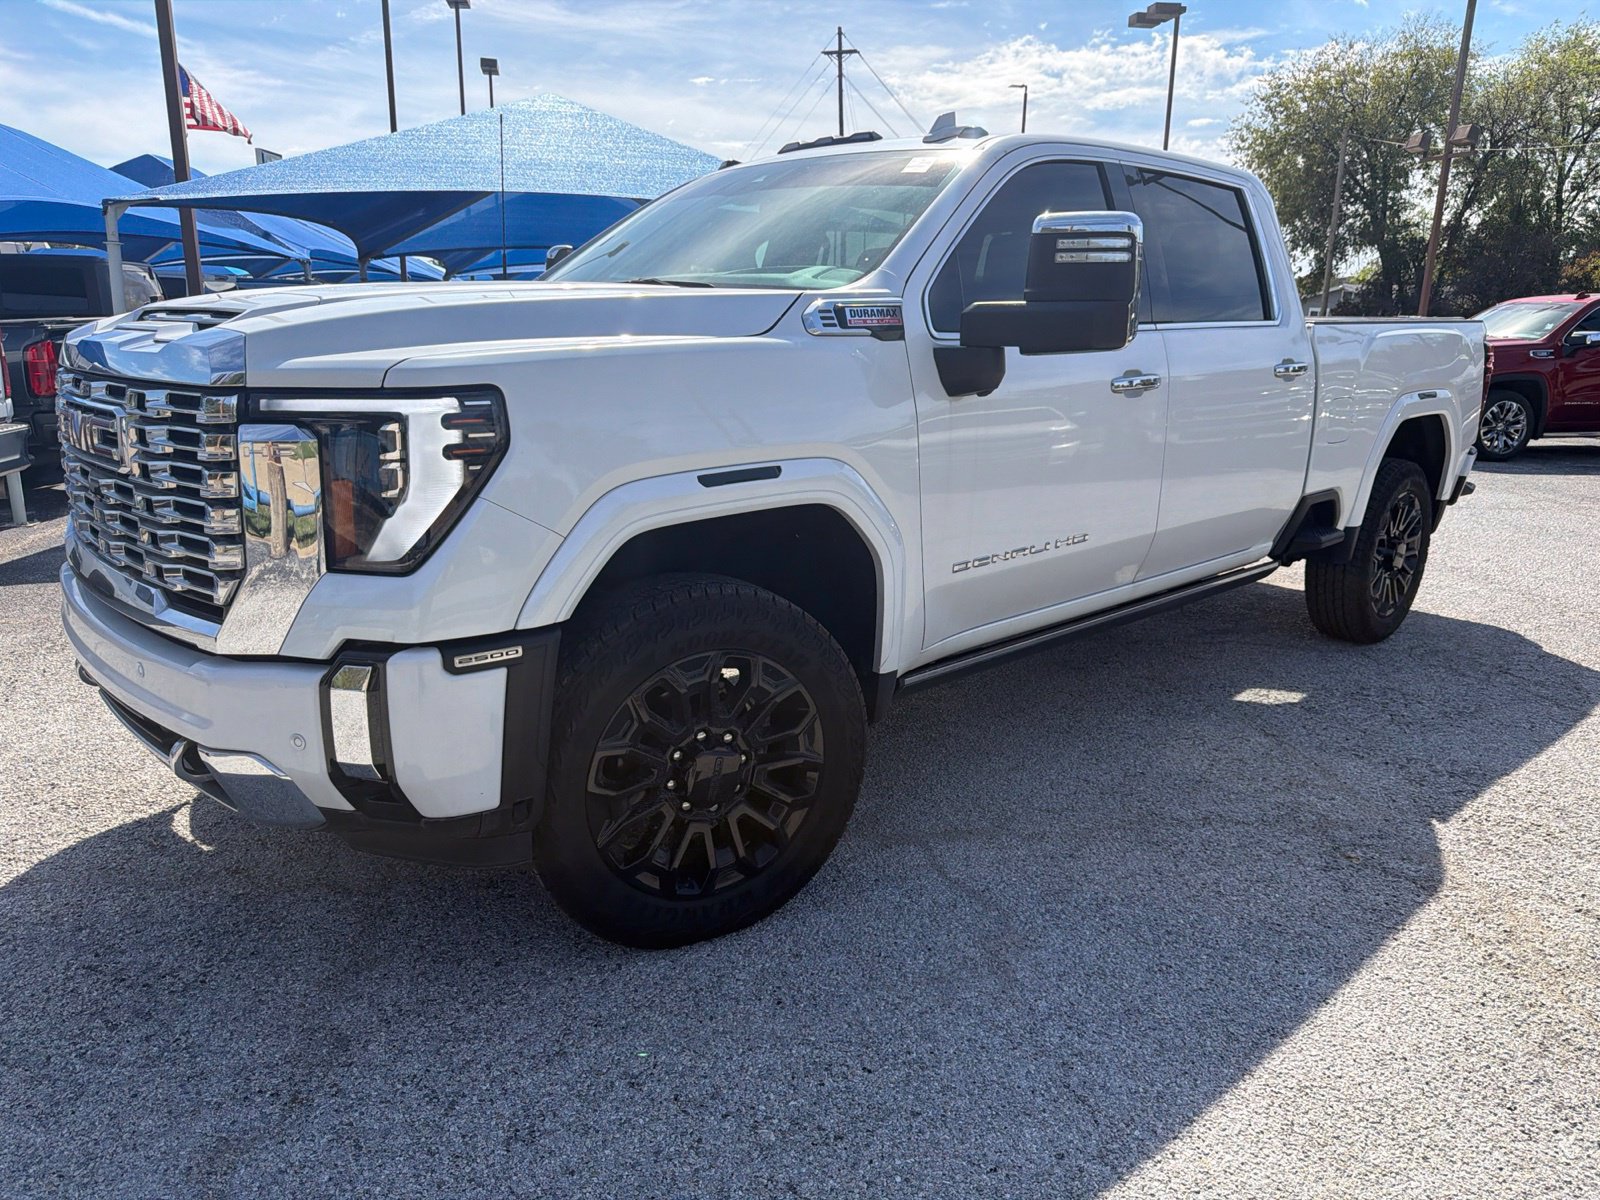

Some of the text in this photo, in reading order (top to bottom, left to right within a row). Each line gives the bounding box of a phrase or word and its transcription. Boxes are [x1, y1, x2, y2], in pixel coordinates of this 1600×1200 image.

[849, 307, 899, 319] DURAMAX
[951, 533, 1089, 573] DENALI HD
[456, 647, 520, 666] 2500
